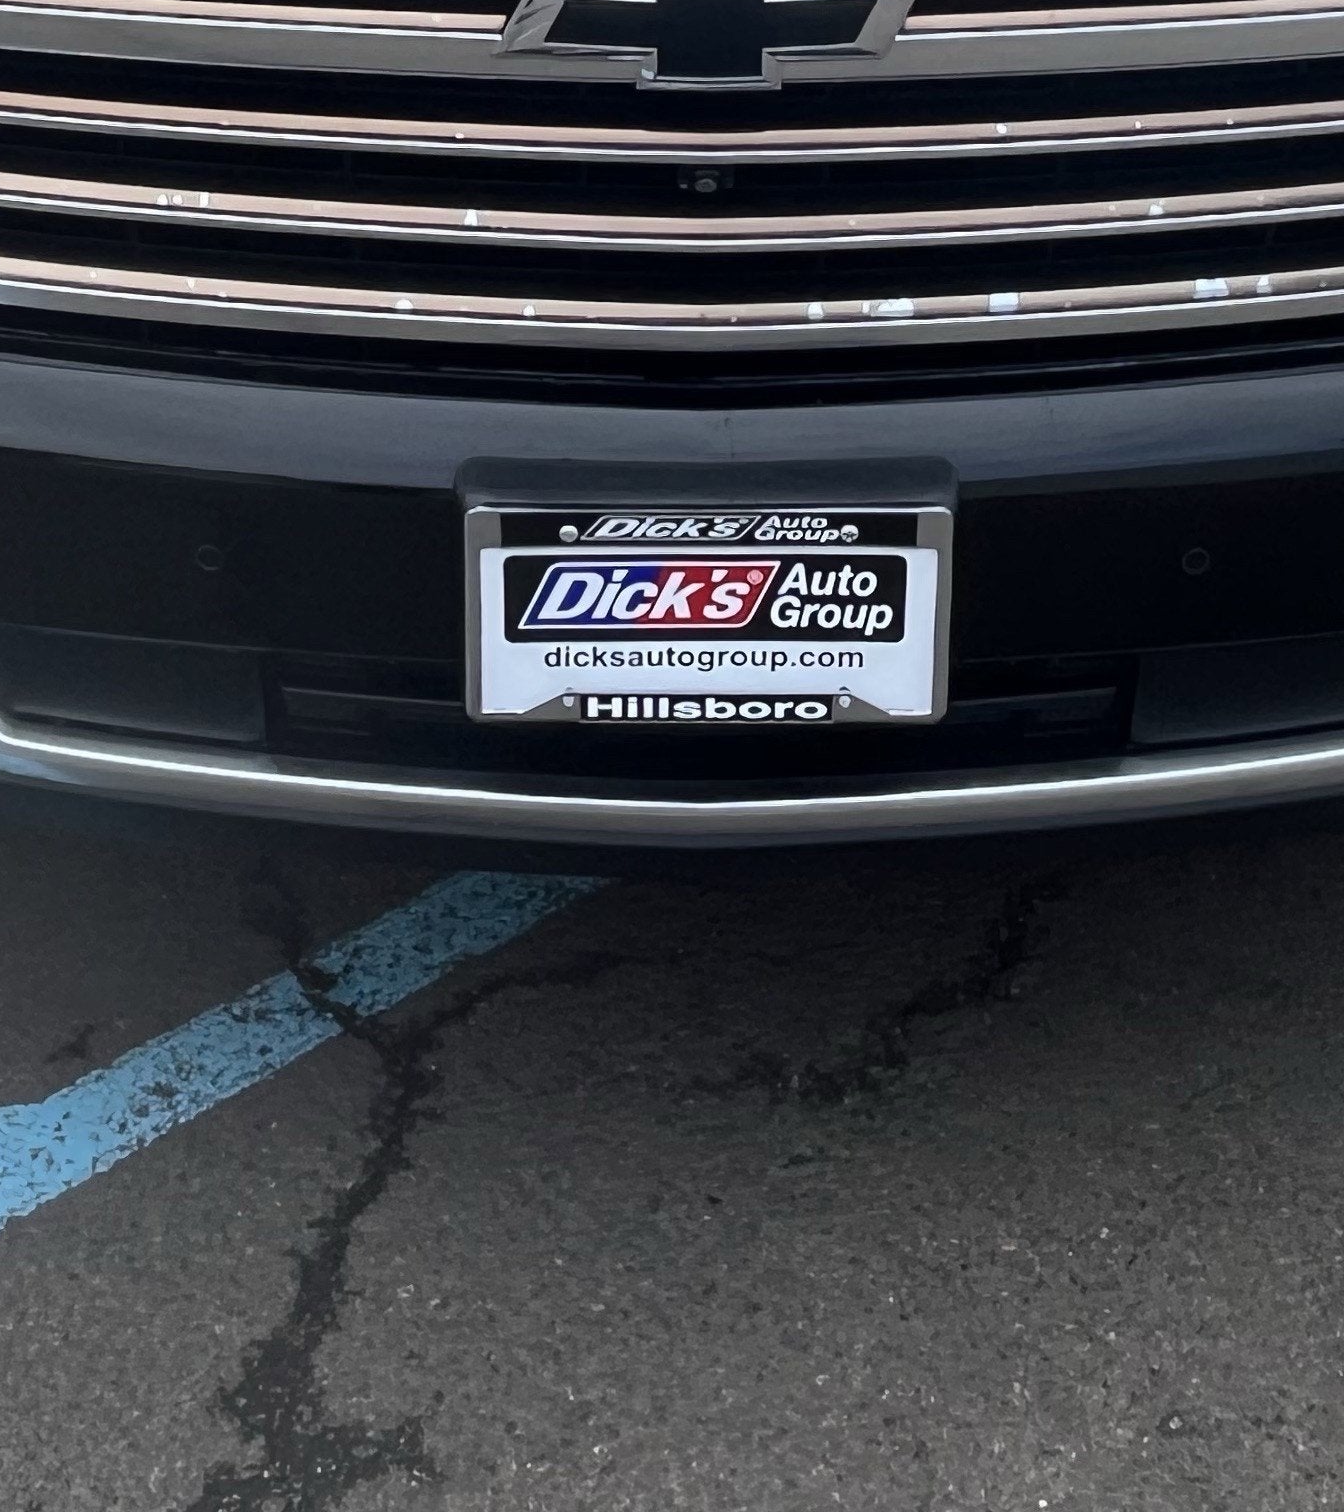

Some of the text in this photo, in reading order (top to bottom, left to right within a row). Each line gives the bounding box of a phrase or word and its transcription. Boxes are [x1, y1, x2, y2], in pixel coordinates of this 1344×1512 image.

[595, 515, 828, 539] Dick's Auto
[754, 527, 840, 543] Group
[537, 562, 878, 620] Dick's Auto
[770, 596, 894, 636] Group
[544, 646, 865, 672] dicksautogroup.com
[586, 696, 829, 719] Hillsboro
